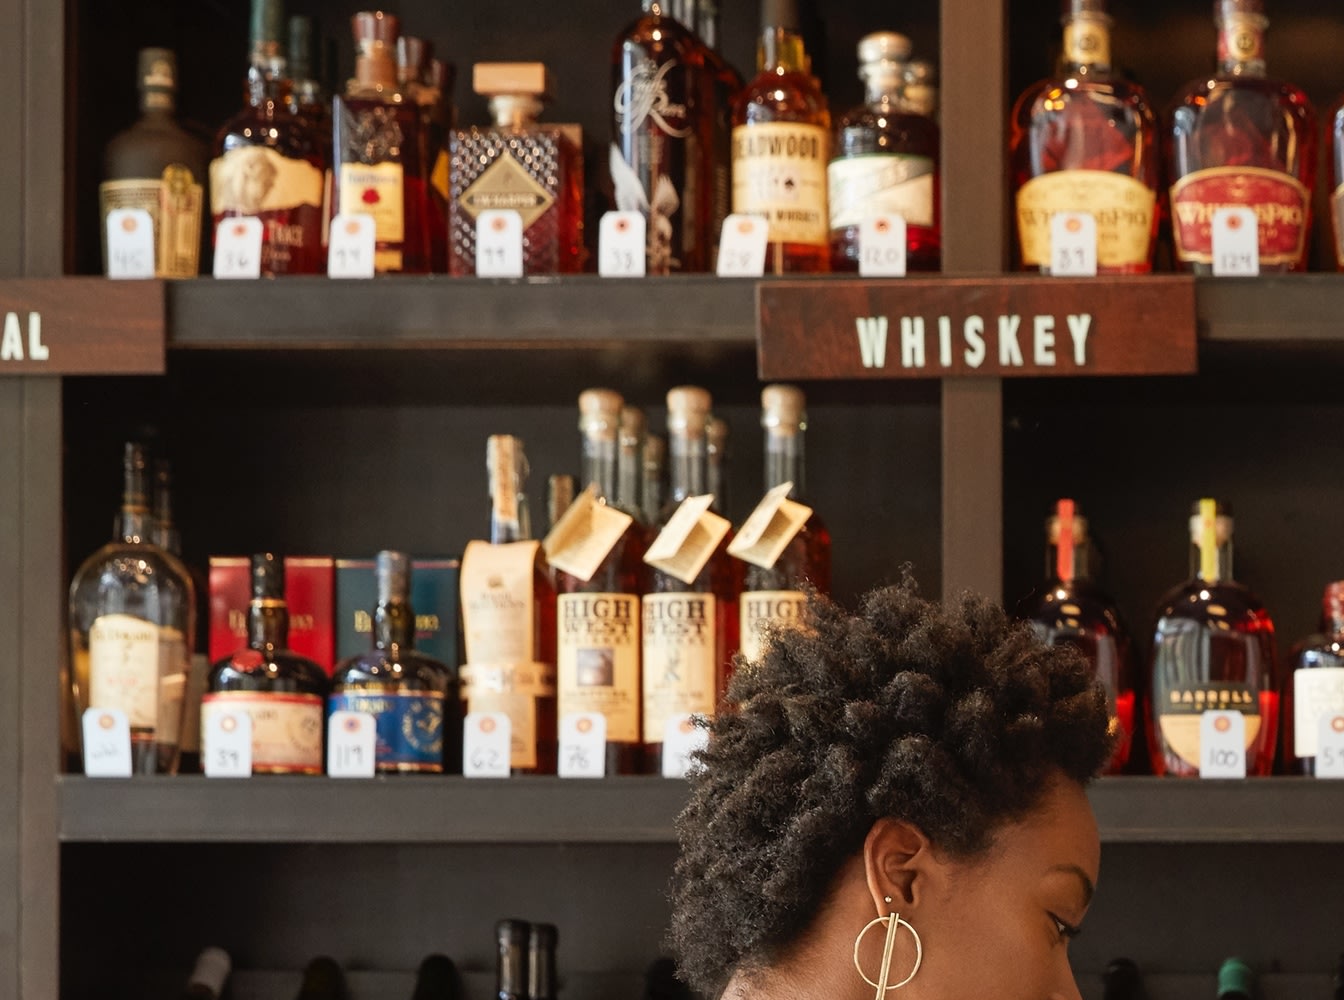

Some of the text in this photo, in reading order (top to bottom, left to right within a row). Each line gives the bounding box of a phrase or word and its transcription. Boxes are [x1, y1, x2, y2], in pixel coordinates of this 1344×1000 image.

[0, 311, 49, 361] AL
[855, 313, 1092, 368] WHISKEY
[564, 600, 631, 619] HIGH
[1208, 749, 1239, 768] 100
